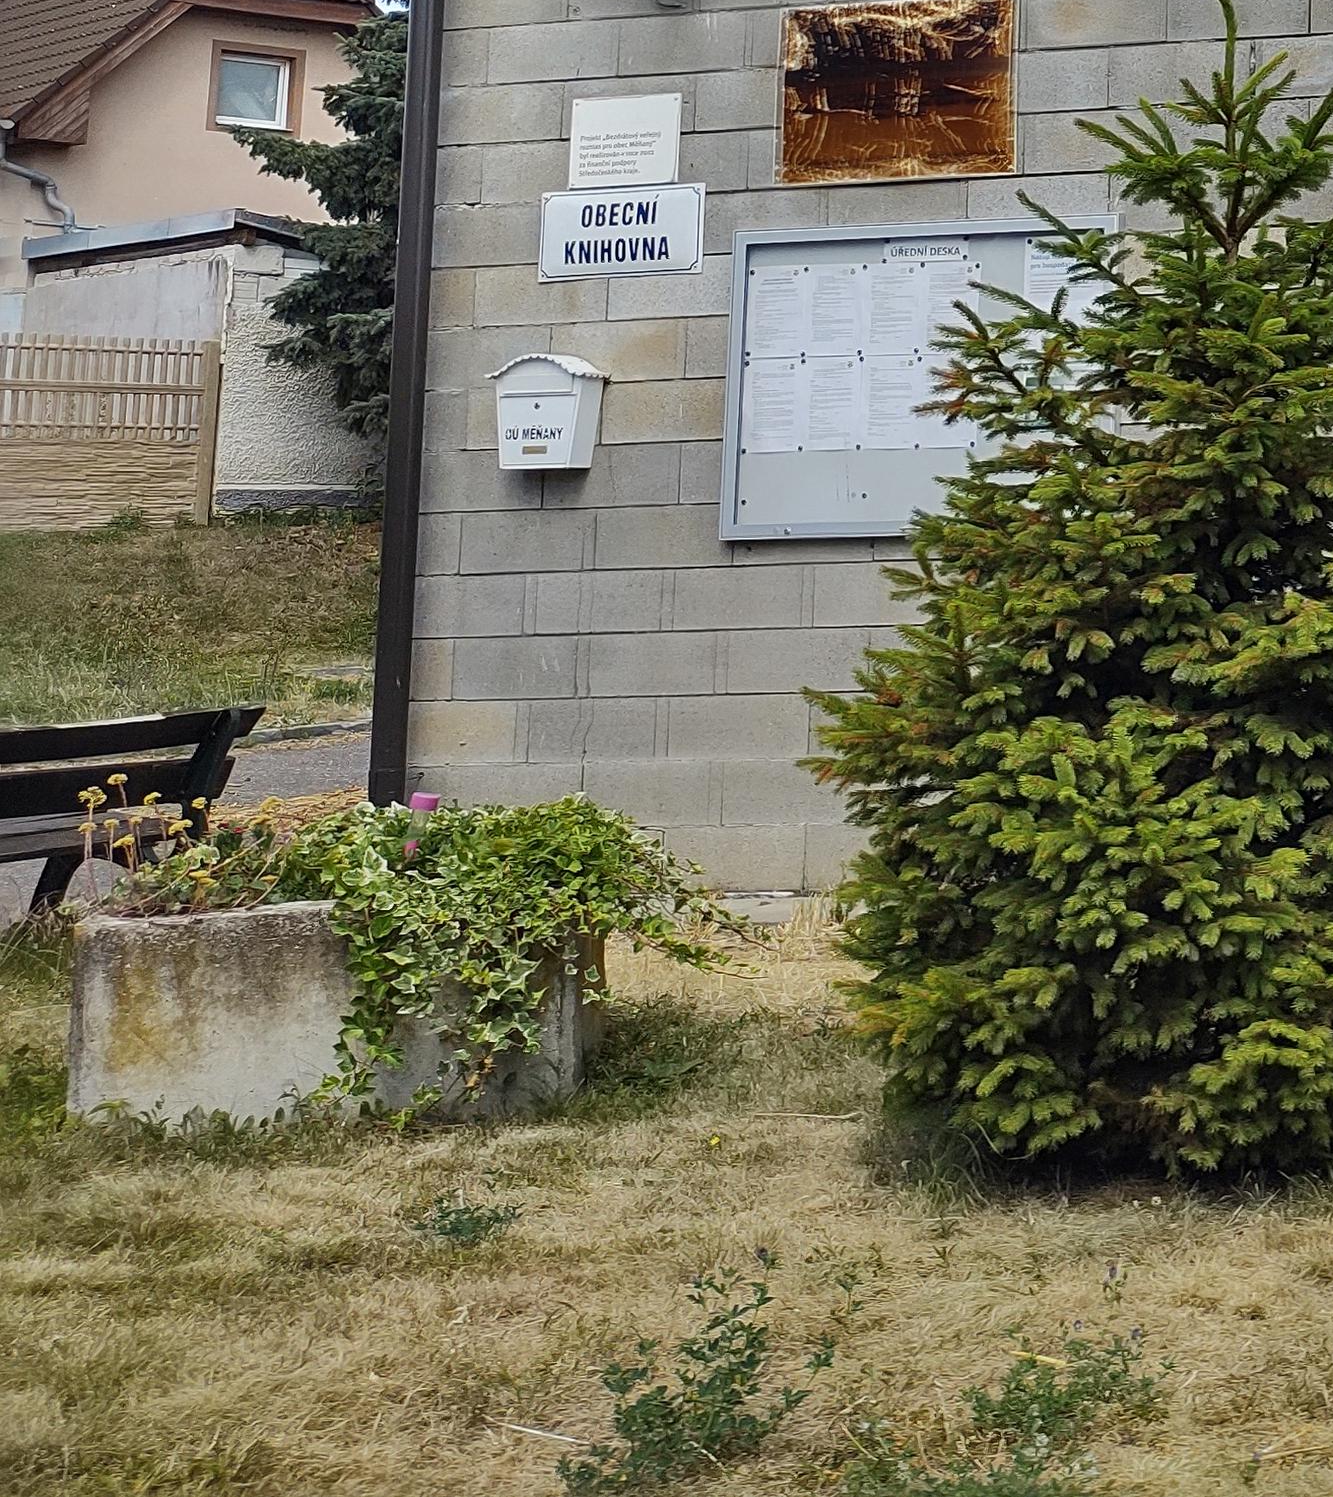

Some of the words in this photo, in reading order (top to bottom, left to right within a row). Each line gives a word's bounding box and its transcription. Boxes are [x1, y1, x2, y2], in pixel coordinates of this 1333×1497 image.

[581, 194, 660, 228] OBECNÍ
[564, 236, 670, 265] KNIHOVNA
[891, 245, 928, 258] ÚŘEDNÍ
[929, 246, 961, 256] DESKA
[521, 424, 564, 440] MĚŇANY
